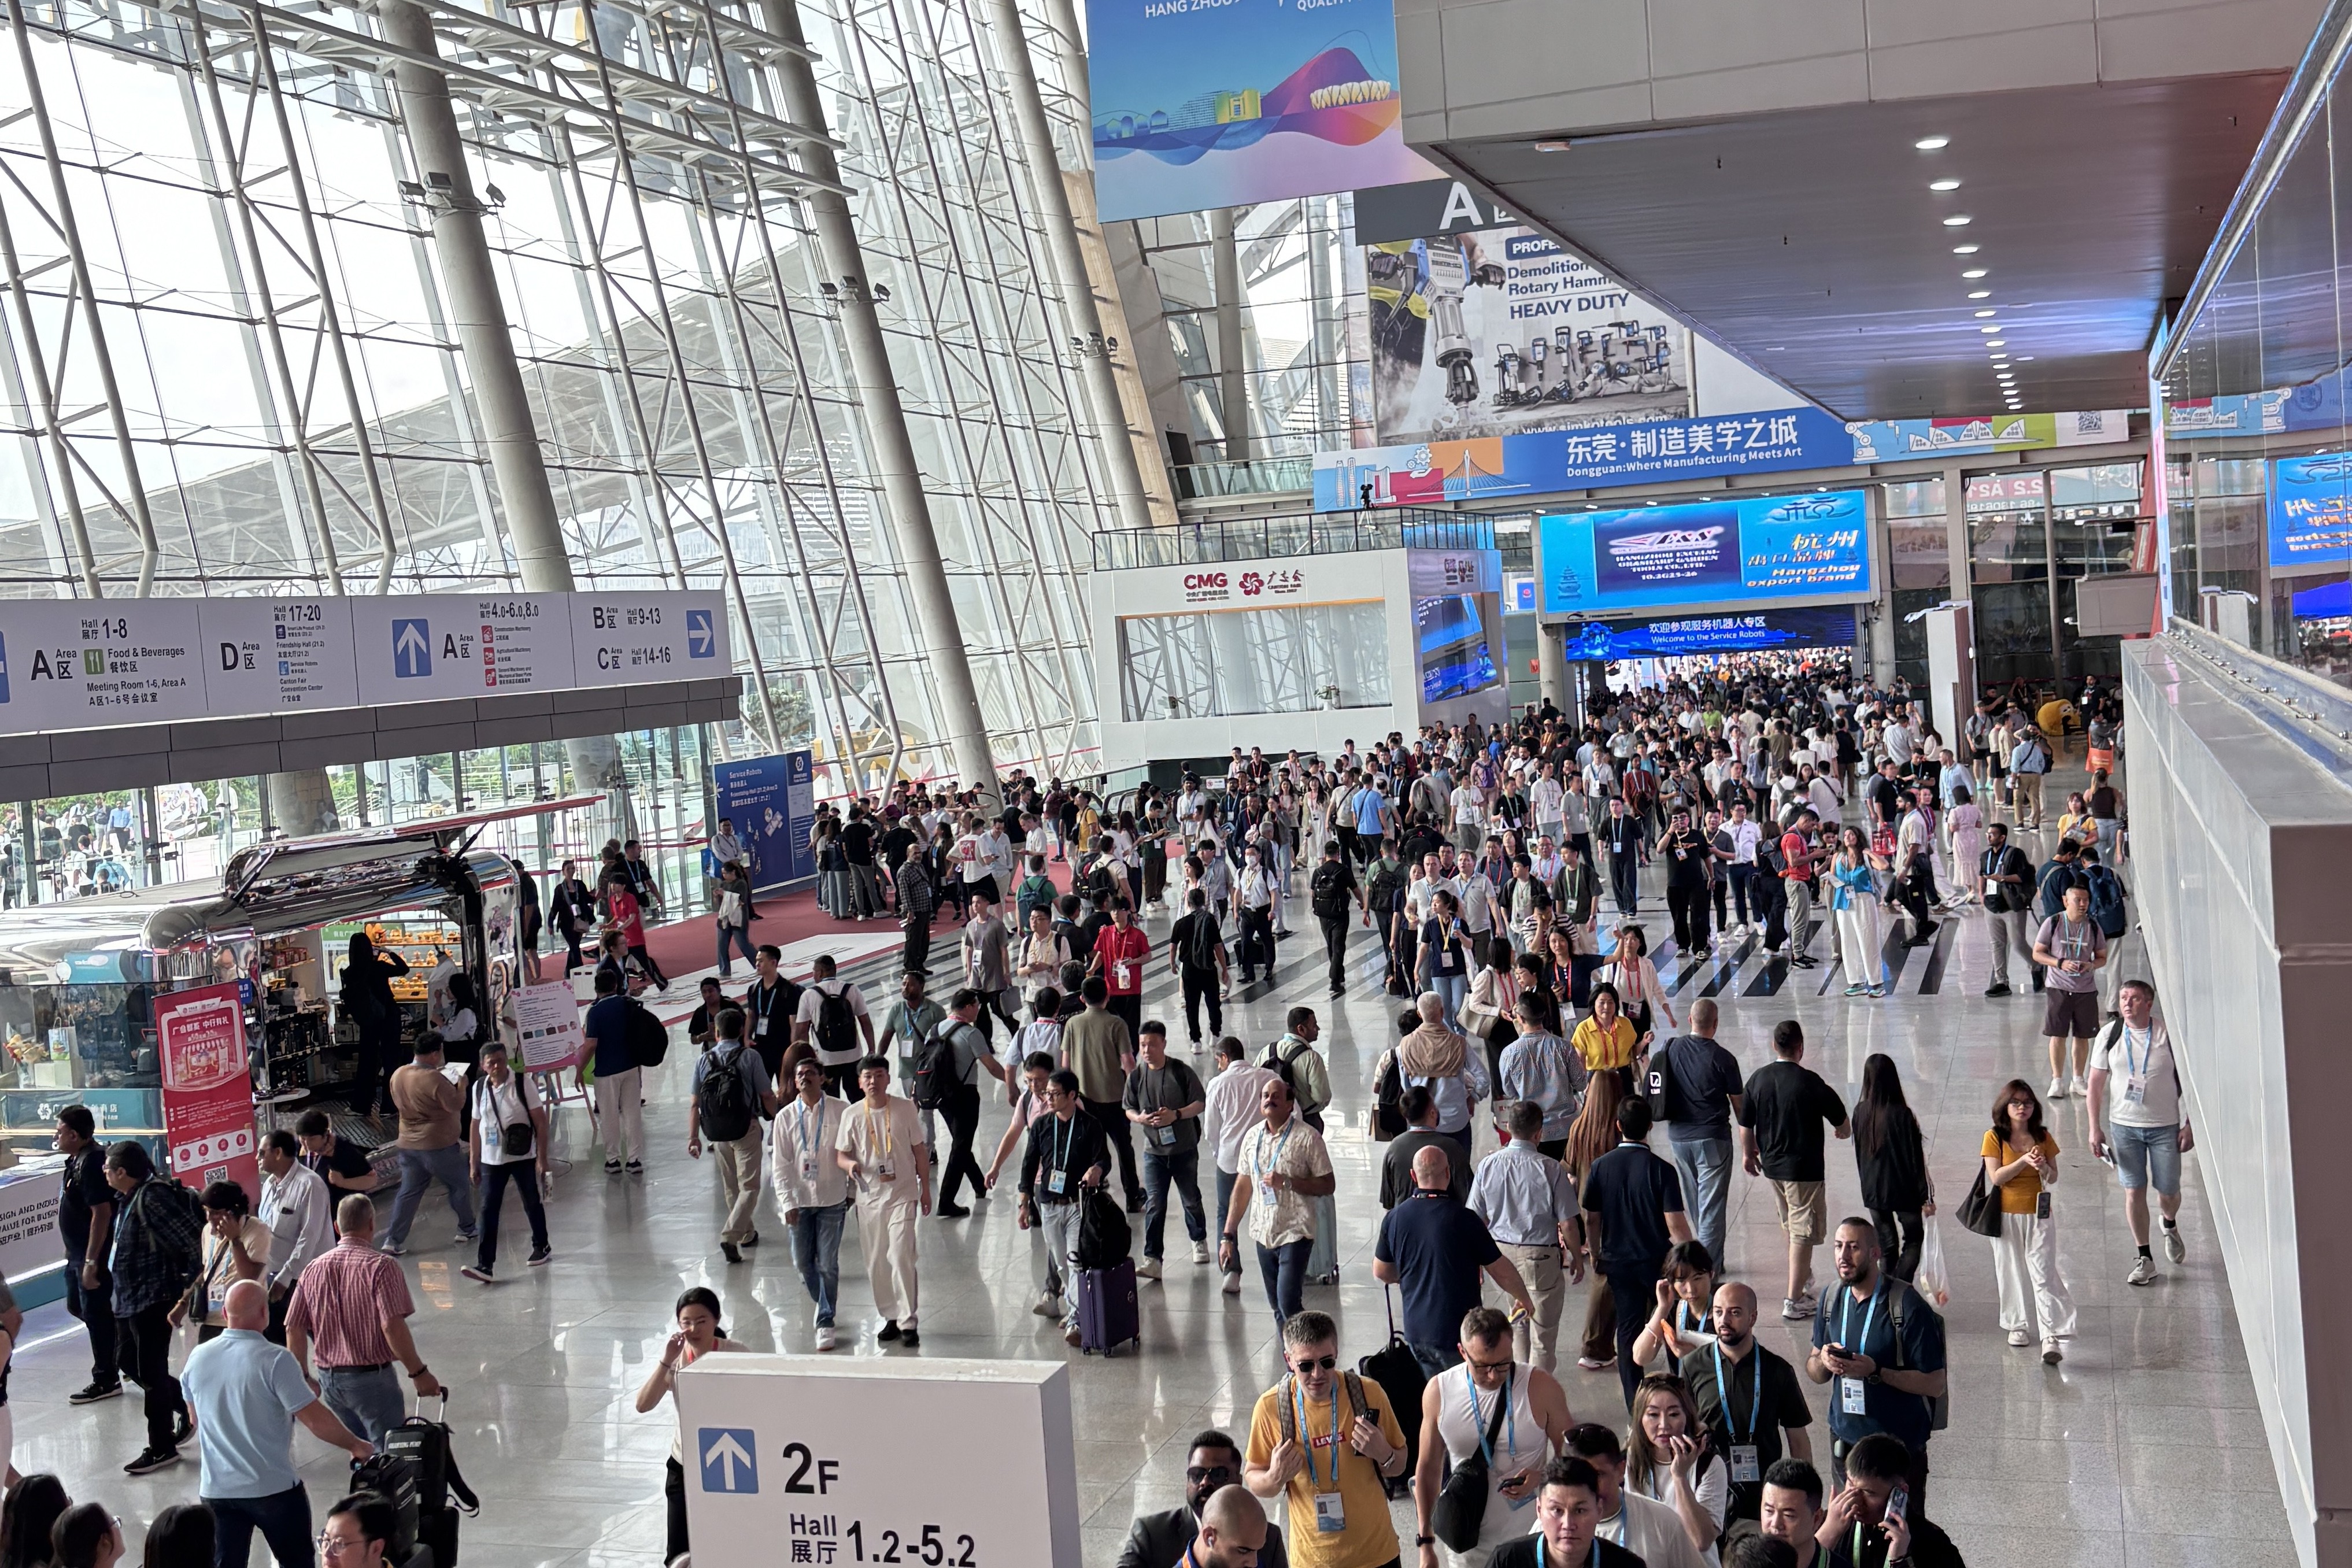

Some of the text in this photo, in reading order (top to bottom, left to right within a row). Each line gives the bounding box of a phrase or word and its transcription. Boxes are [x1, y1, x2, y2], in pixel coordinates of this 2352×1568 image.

[1145, 0, 1187, 18] HANG
[1439, 182, 1484, 230] A
[1512, 239, 1560, 254] PROFE
[1508, 276, 1612, 296] Rotary Hamm
[1510, 293, 1629, 319] HEAVY DUTY
[1522, 415, 1667, 435] www.simkotoolscom
[1663, 453, 1747, 469] Manufacturing
[1748, 449, 1781, 460] Meets
[1784, 447, 1802, 457] Art
[1772, 564, 1861, 576] Hangzhou
[1184, 572, 1228, 590] CMG
[1746, 572, 1856, 587] export brand
[289, 605, 321, 622] 17-20
[491, 601, 539, 620] 4.0-6.0,8.0
[593, 607, 605, 628] B
[638, 608, 661, 624] 9-13
[82, 618, 128, 638] Hall 1-8
[607, 615, 616, 628] 区
[1649, 616, 1766, 634] 欢迎参观服务机器人专区
[82, 630, 98, 639] 展厅
[460, 634, 474, 642] Area
[1651, 635, 1685, 644] Welcome
[1711, 631, 1737, 640] Service
[56, 649, 77, 659] Area
[108, 647, 185, 658] Food & Beverages
[242, 641, 260, 650] Area
[443, 633, 458, 659] A
[461, 644, 470, 659] 区
[220, 642, 239, 671] D
[244, 653, 256, 670] 区
[597, 648, 609, 670] C
[612, 656, 620, 669] 区
[643, 646, 671, 664] 14-16
[31, 649, 54, 681] A
[57, 661, 73, 679] 区
[110, 661, 139, 674] 餐饮区
[87, 682, 119, 692] Meeting
[121, 681, 143, 690] Room
[161, 679, 178, 687] Area
[180, 678, 186, 686] A
[89, 693, 158, 706] A区1-6号会议室
[18, 1205, 35, 1215] AND
[21, 1216, 35, 1226] FOR
[1316, 1433, 1343, 1446] LEVS
[783, 1442, 839, 1495] 2F
[790, 1513, 976, 1567] Hall 1.2-5.2
[792, 1540, 837, 1565] 展厅
